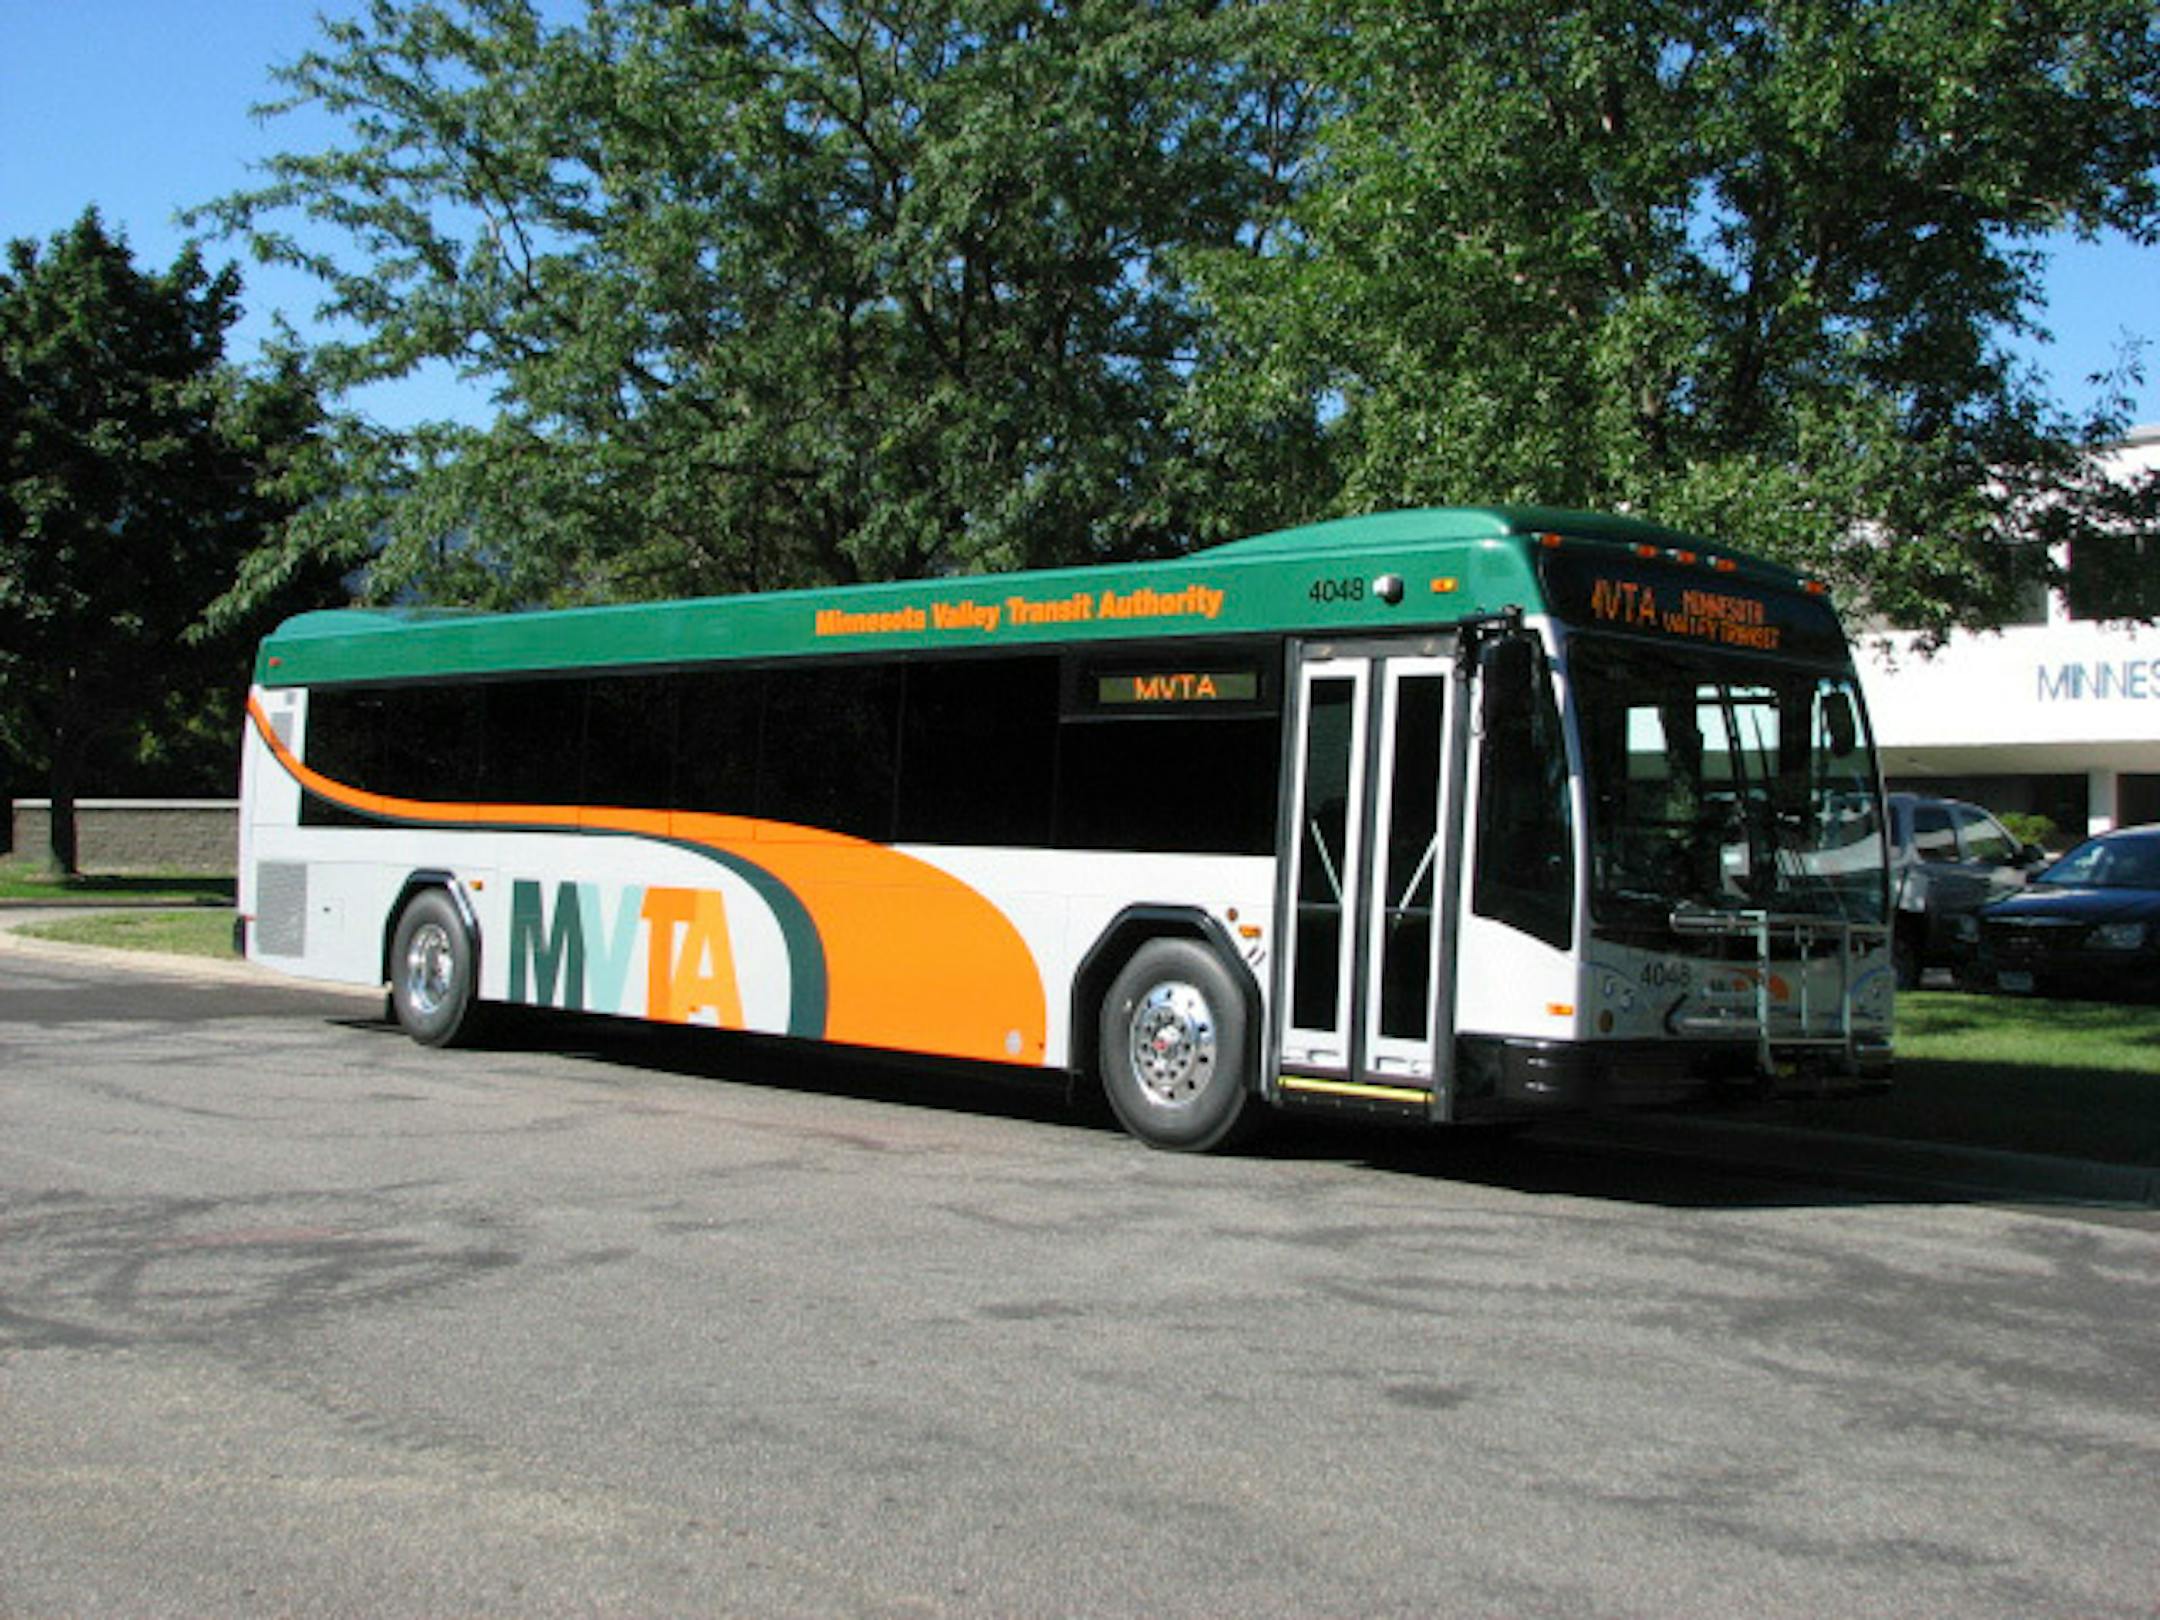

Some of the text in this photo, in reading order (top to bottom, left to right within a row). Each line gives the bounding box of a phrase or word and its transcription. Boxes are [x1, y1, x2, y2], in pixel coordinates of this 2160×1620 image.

[1309, 577, 1364, 603] 4048
[815, 585, 1225, 636] Minnesota Valley Transit Authority
[1133, 673, 1217, 702] MVTA
[509, 878, 745, 1029] MVTA
